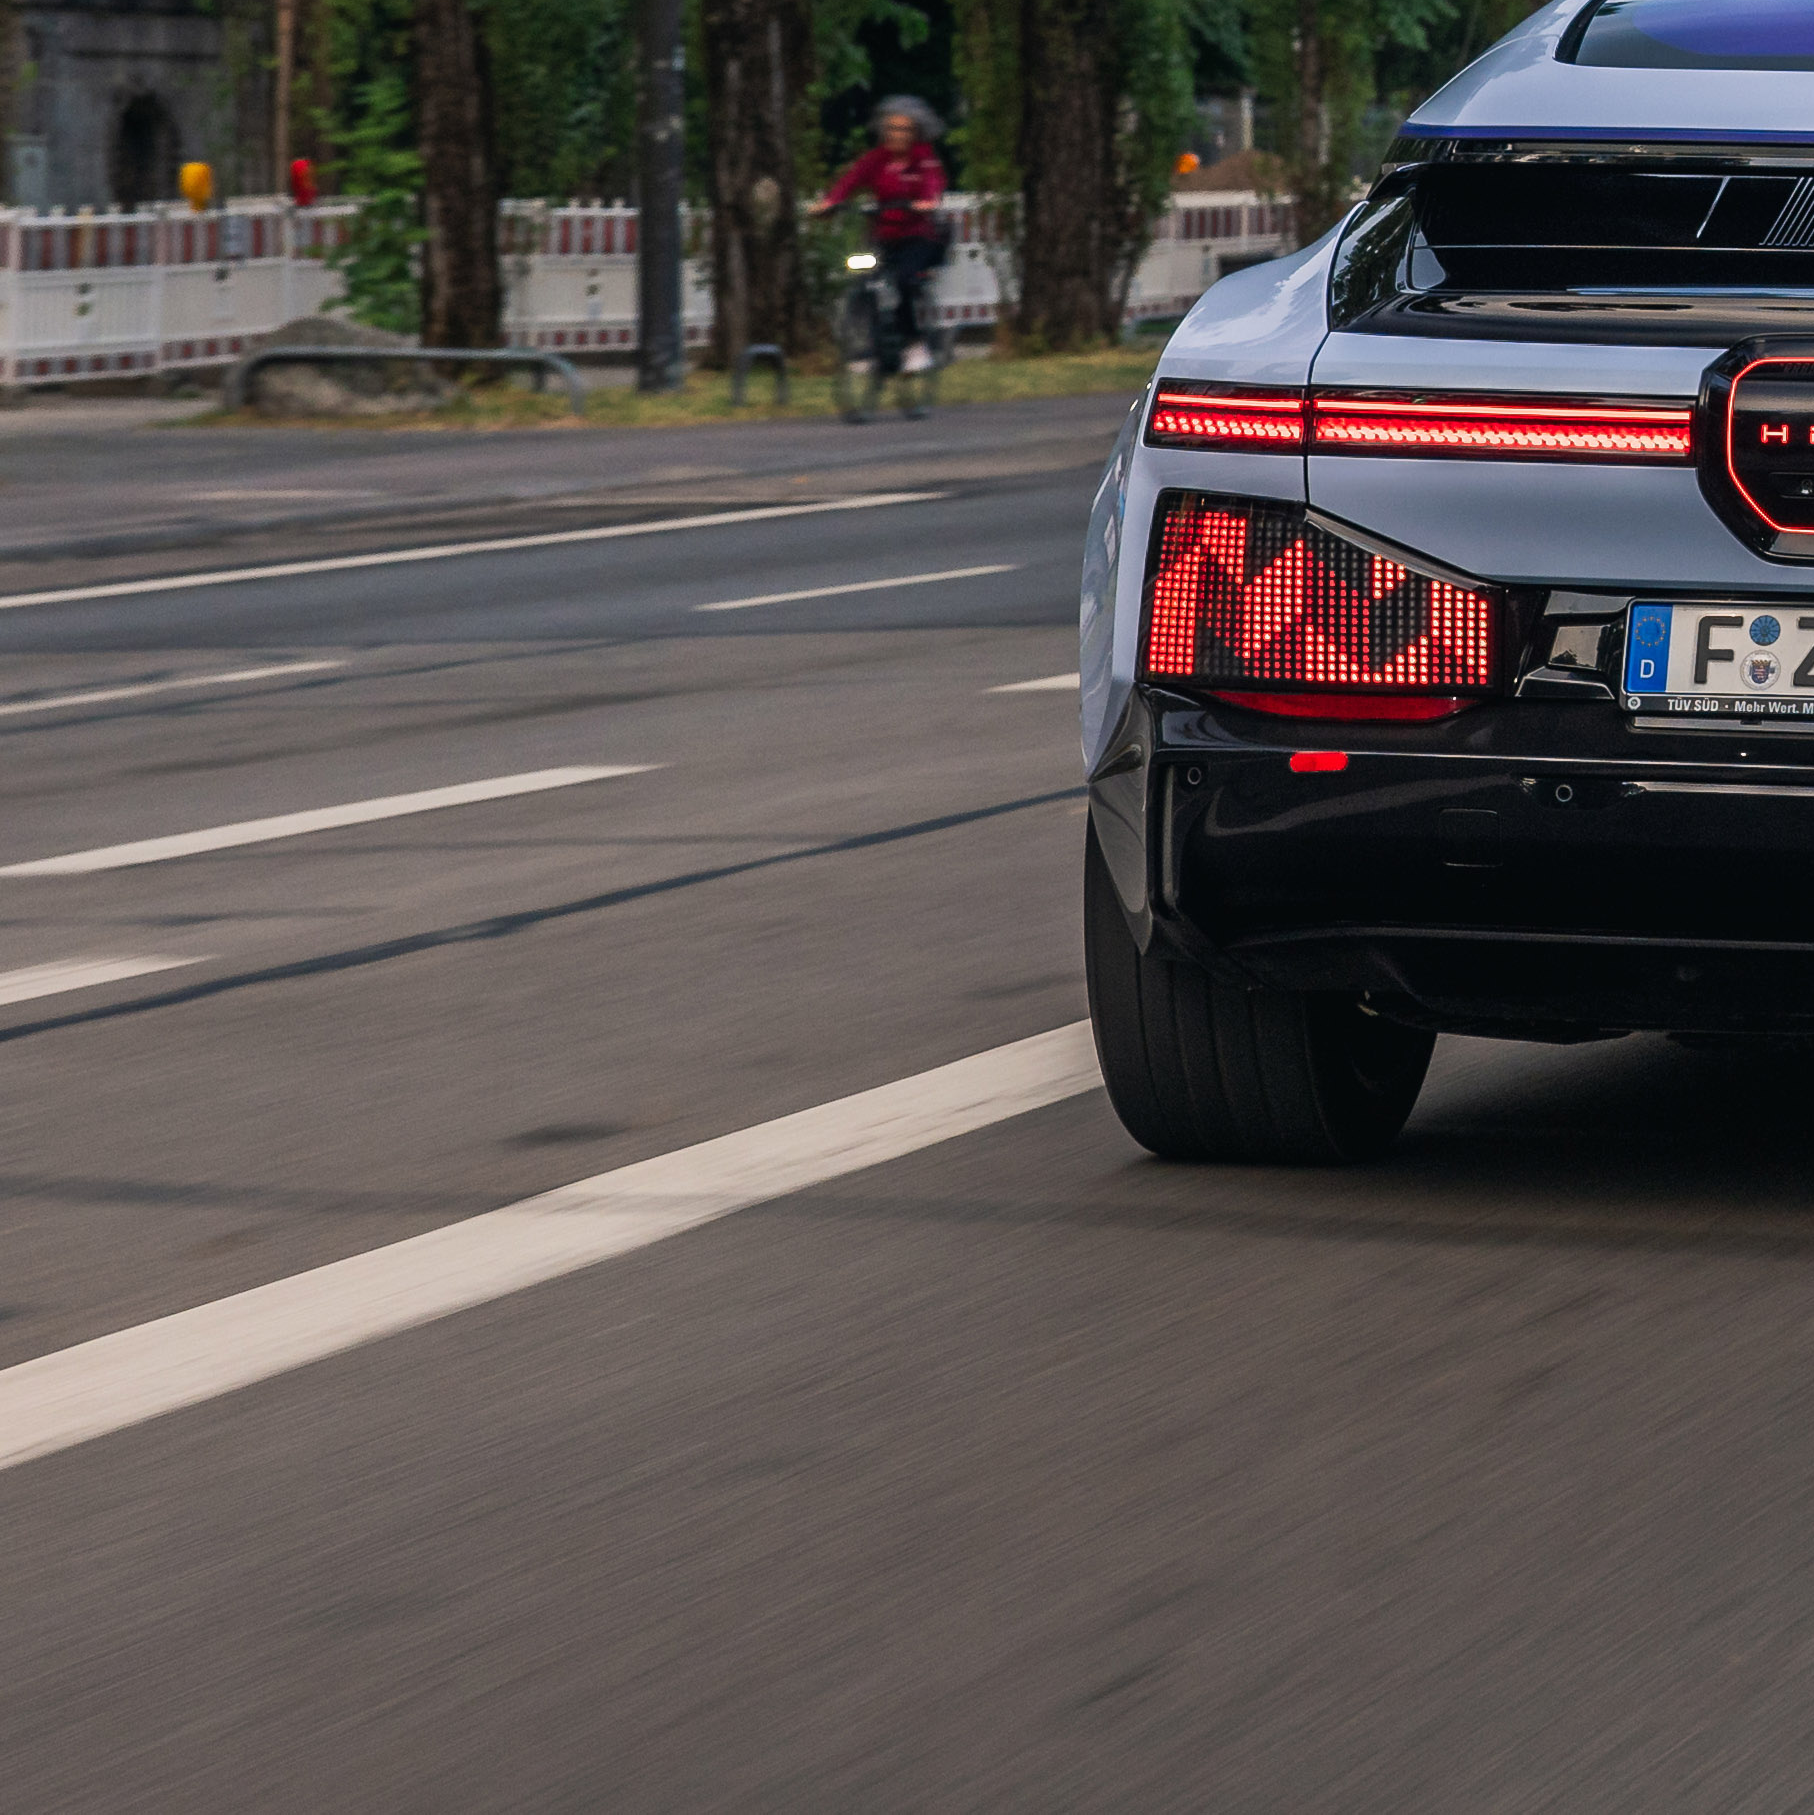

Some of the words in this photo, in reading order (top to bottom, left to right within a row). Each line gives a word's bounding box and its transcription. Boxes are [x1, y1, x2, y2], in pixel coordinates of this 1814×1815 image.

[1694, 615, 1744, 685] F
[1639, 659, 1654, 679] D
[1668, 696, 1691, 711] TÜV
[1694, 697, 1719, 712] SÜD
[1734, 701, 1765, 713] Mehr
[1769, 701, 1799, 714] Wert.
